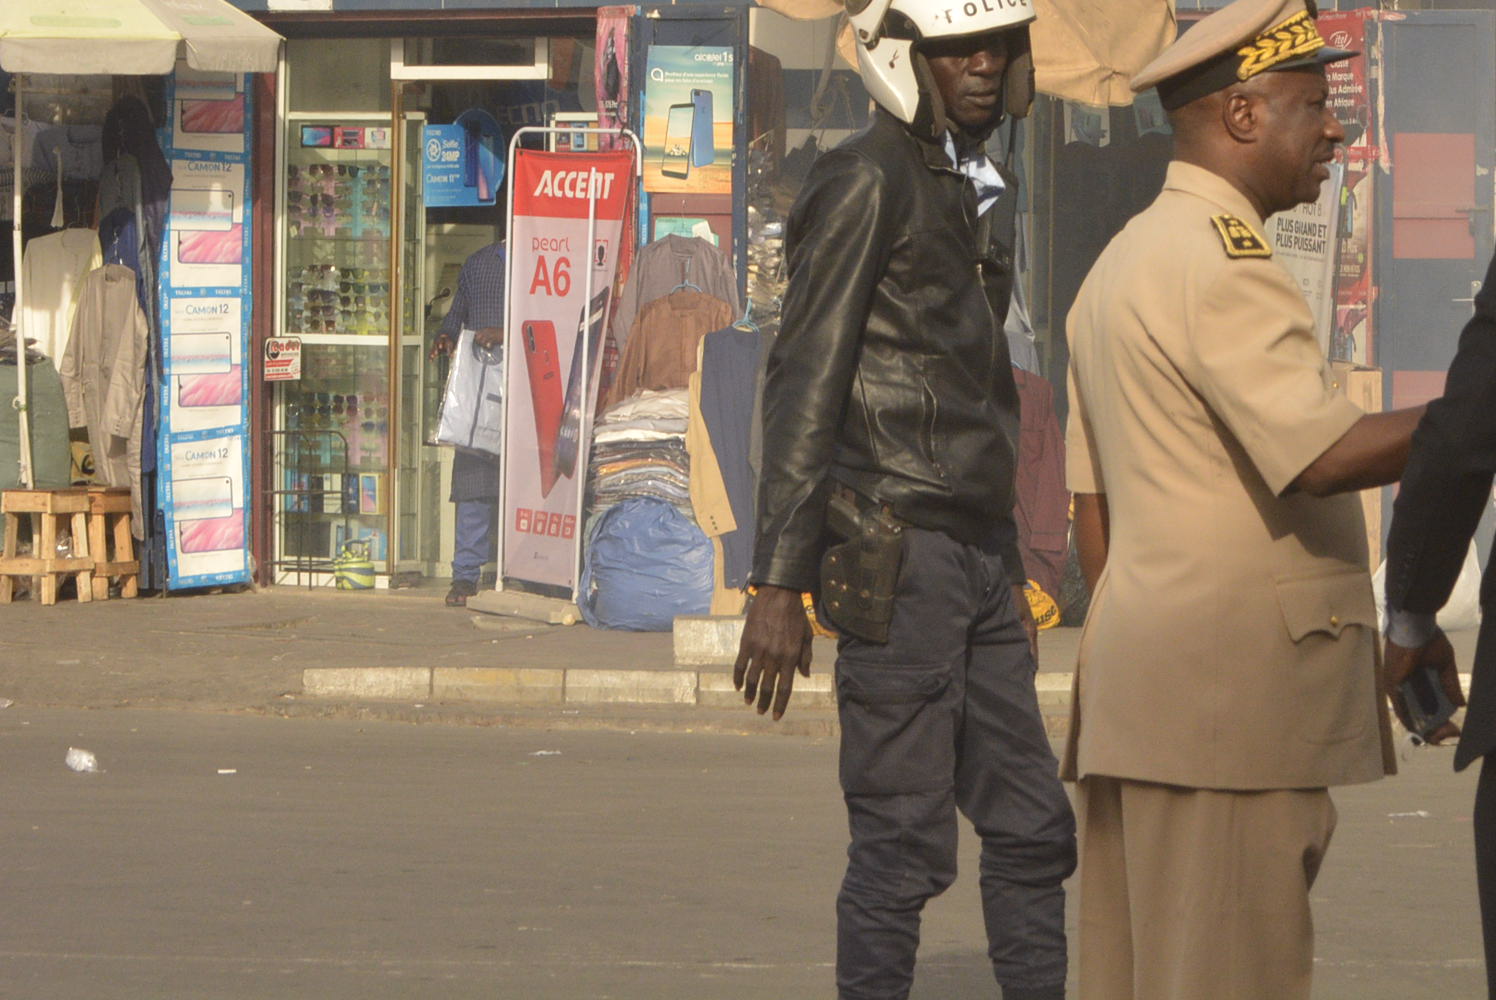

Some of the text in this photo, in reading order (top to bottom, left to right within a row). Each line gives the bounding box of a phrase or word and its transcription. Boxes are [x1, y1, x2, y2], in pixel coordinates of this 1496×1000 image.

[1277, 217, 1294, 234] PLUS
[1318, 224, 1328, 238] ET
[532, 237, 571, 253] pearl
[1275, 233, 1293, 249] PLUS
[529, 255, 572, 298] A6
[219, 303, 229, 315] 12
[218, 448, 229, 460] 12
